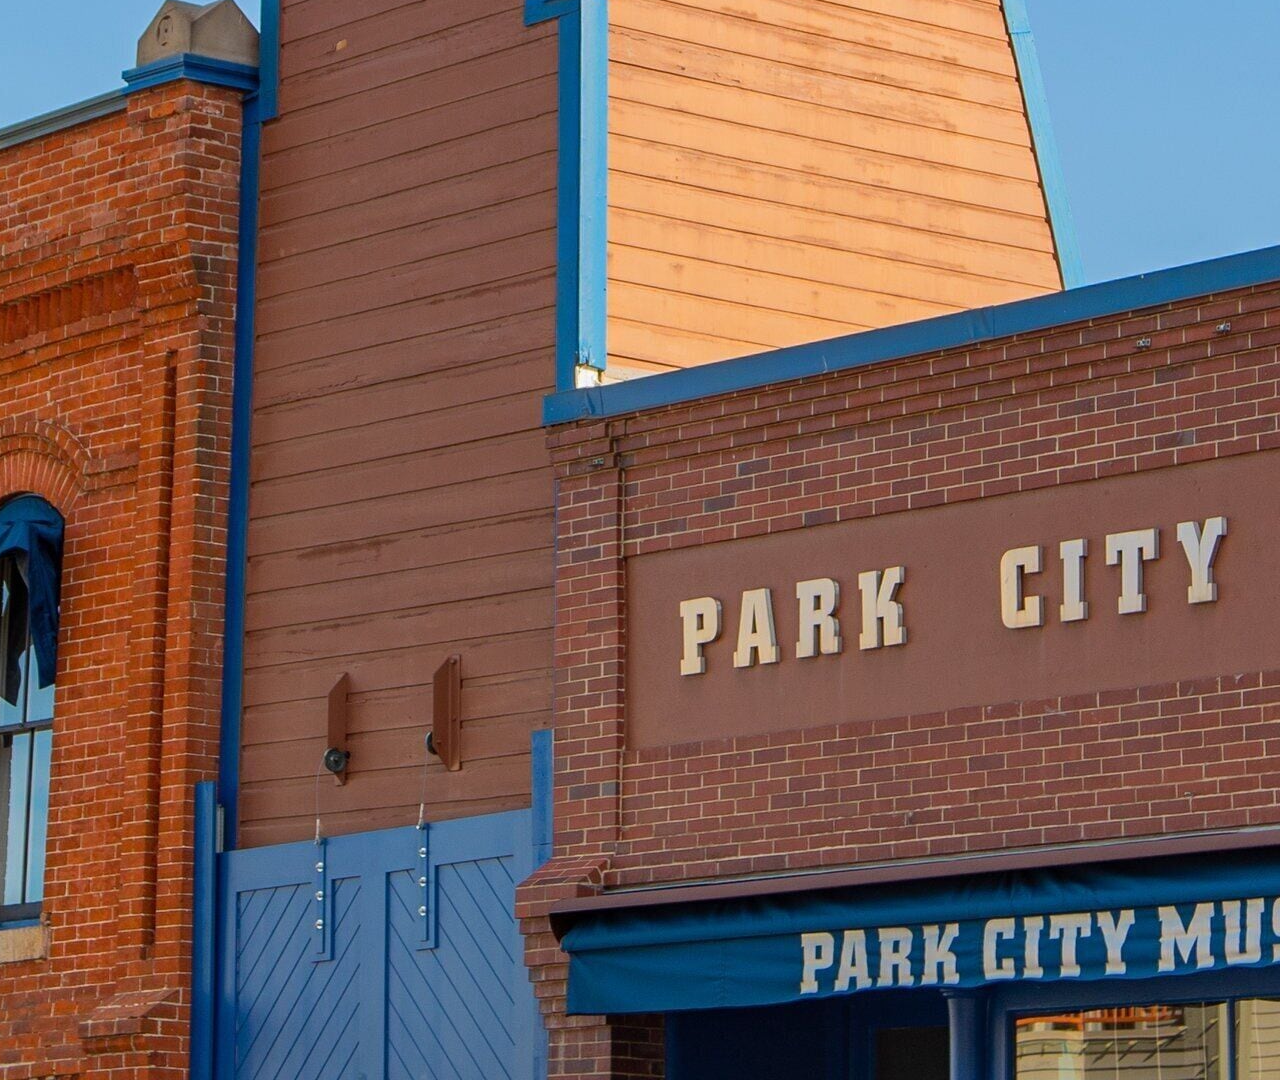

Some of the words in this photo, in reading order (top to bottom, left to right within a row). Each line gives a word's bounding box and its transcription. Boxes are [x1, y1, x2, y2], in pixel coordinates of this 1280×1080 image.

[679, 566, 908, 676] PARK
[1000, 516, 1228, 629] CITY
[800, 923, 960, 994] PARK
[983, 909, 1135, 980] CITY
